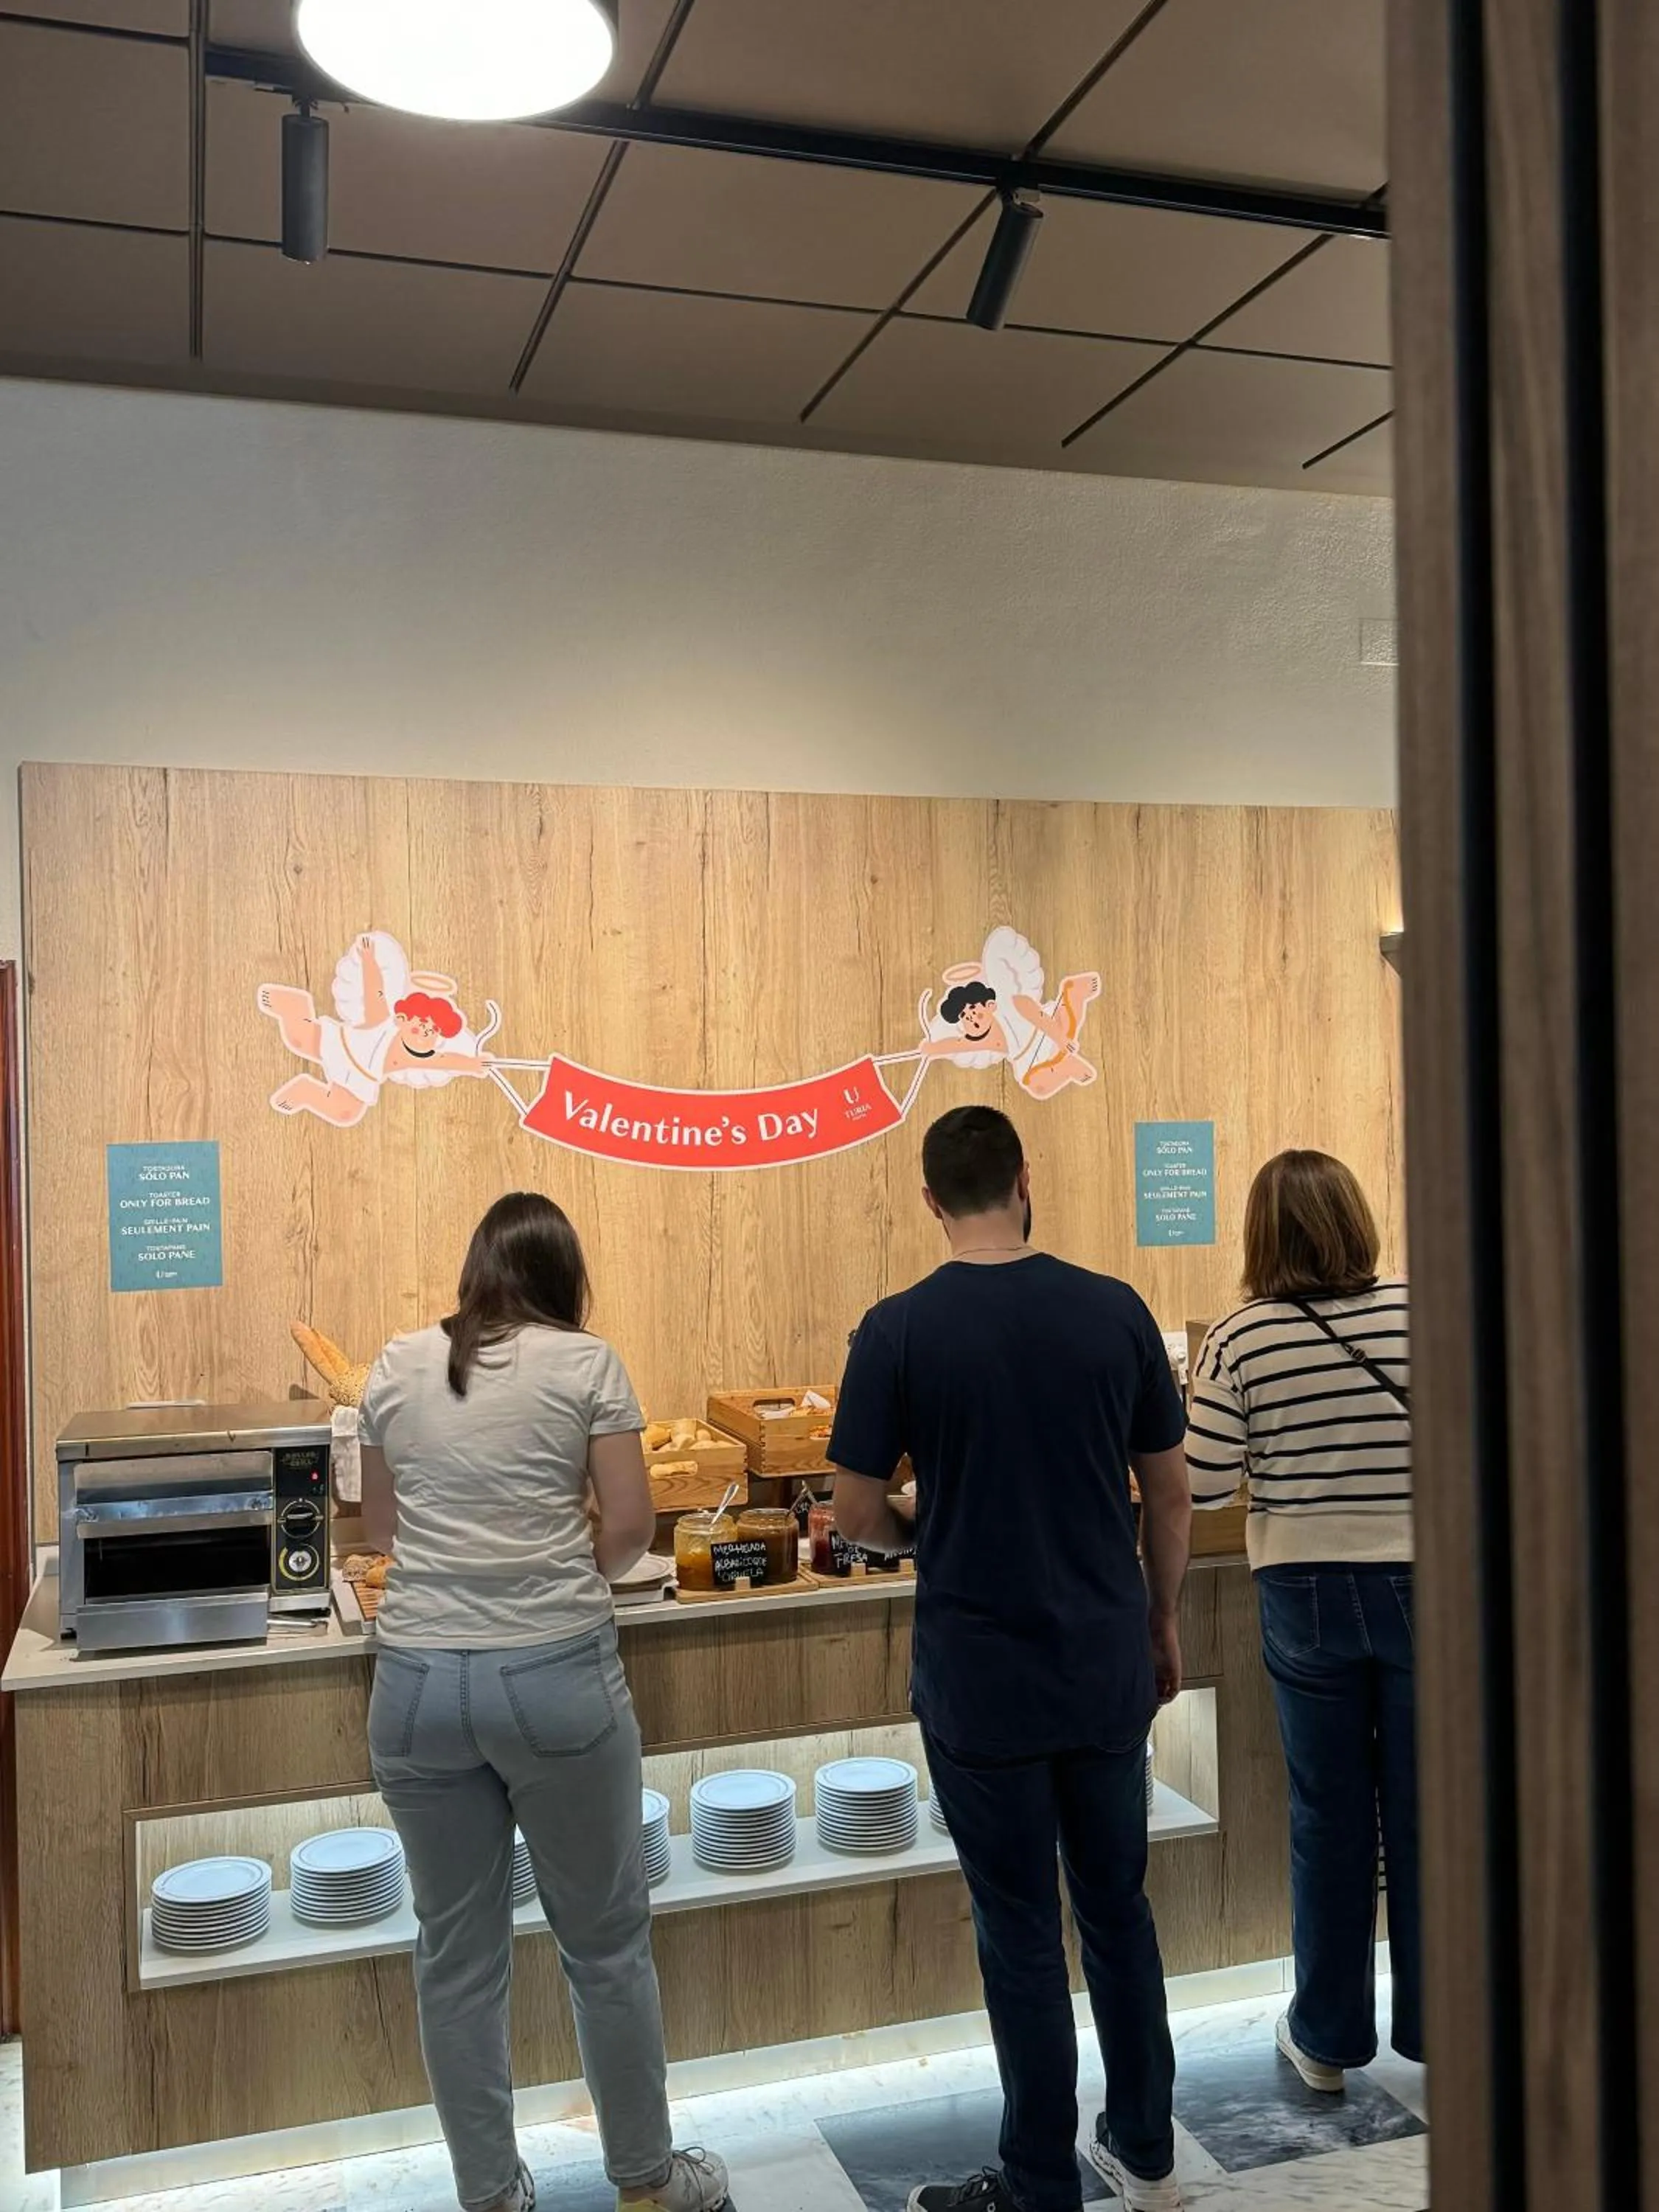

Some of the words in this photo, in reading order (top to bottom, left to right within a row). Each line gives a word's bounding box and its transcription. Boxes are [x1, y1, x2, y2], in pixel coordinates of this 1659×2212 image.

[564, 1091, 746, 1146] Valentine’s
[758, 1108, 818, 1141] Day
[170, 1172, 189, 1180] PAN
[120, 1199, 147, 1208] ONLY
[150, 1198, 171, 1207] FOR
[175, 1197, 210, 1206] BREAD
[186, 1223, 210, 1232] PAIN
[138, 1251, 166, 1261] SOLO
[169, 1250, 195, 1259] PANE
[833, 1551, 869, 1569] FRESA
